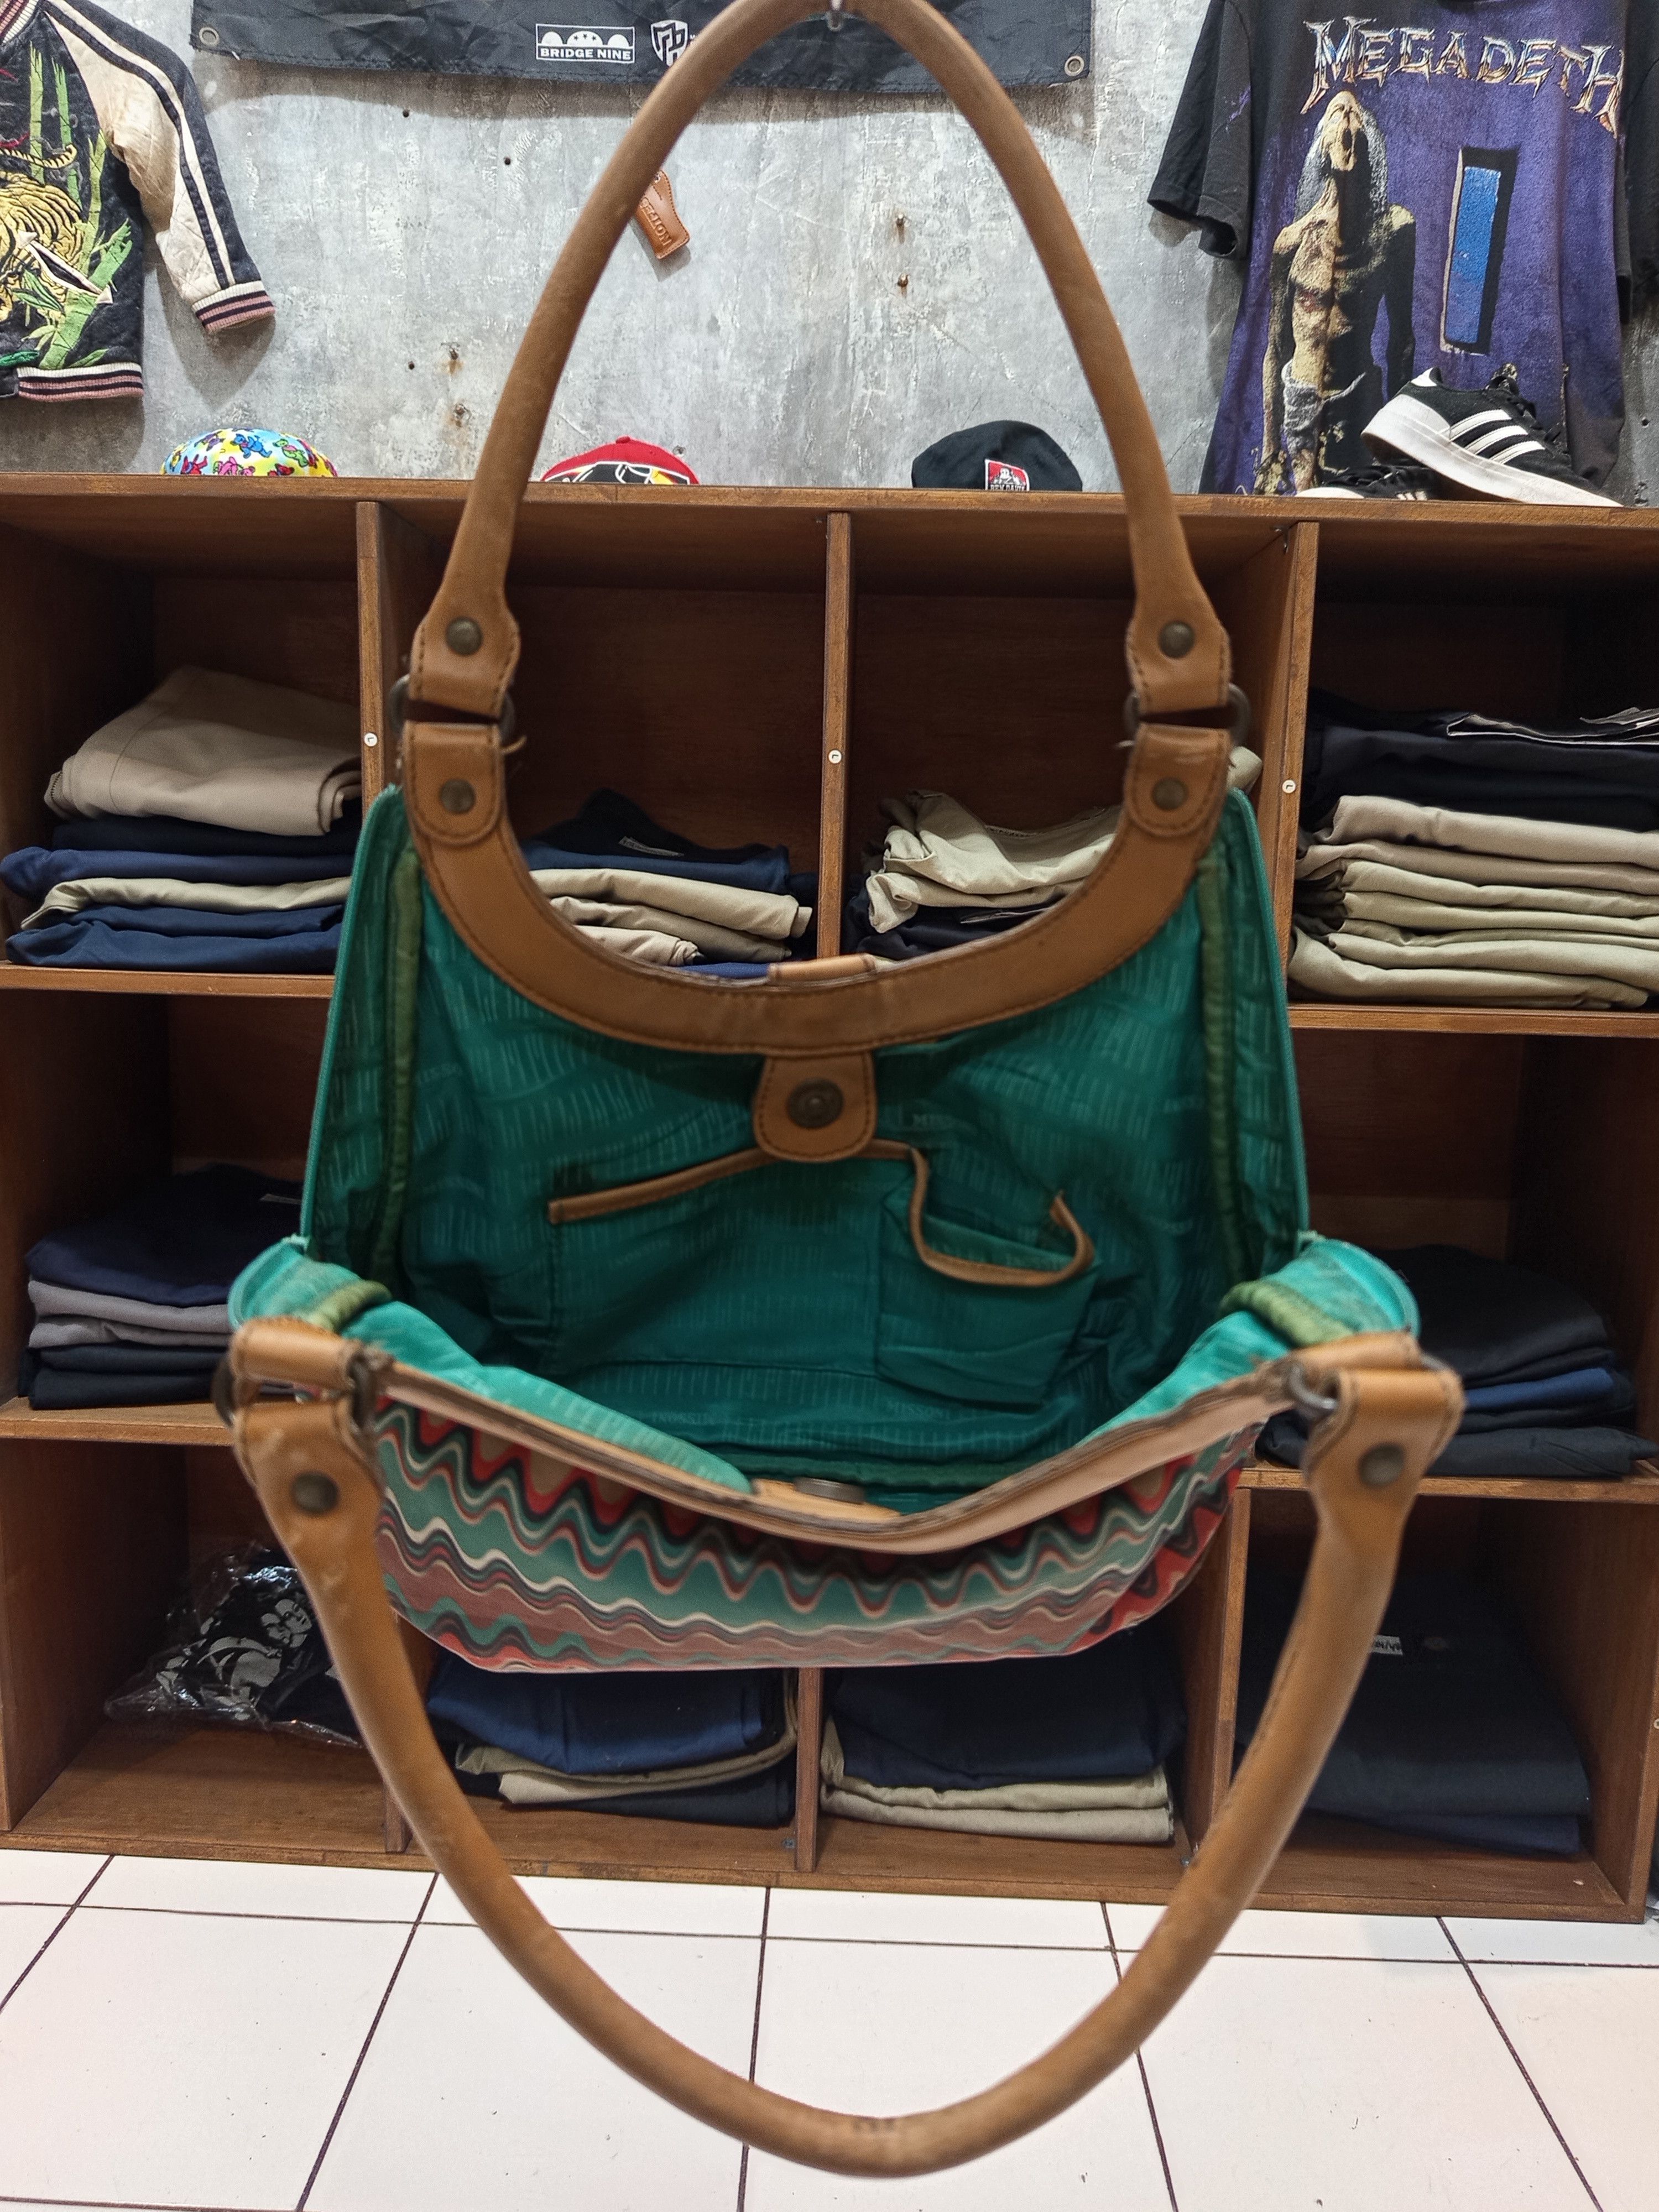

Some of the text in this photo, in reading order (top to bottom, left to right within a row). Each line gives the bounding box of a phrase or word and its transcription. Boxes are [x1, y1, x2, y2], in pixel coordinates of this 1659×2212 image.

[540, 47, 632, 60] BRIDGE NINE
[1301, 16, 1624, 139] MEGADETH
